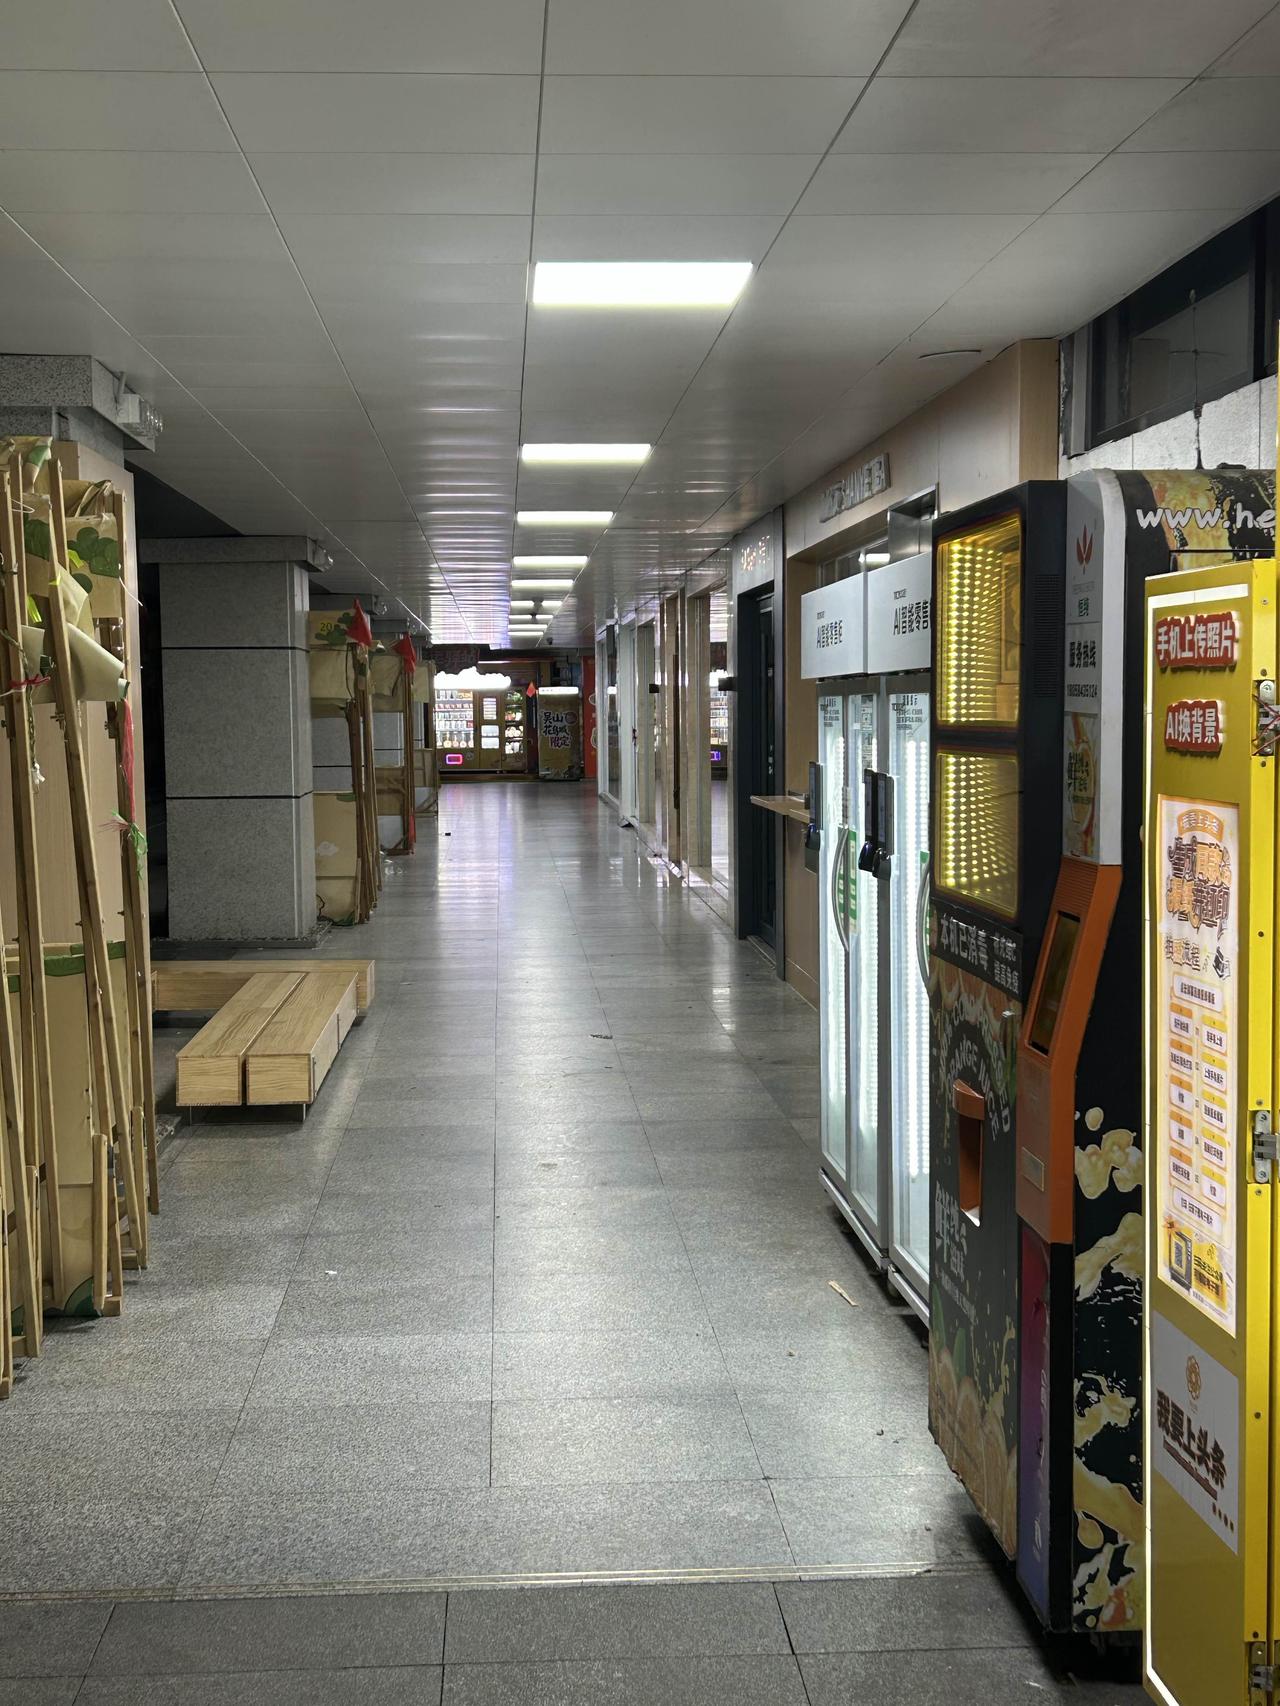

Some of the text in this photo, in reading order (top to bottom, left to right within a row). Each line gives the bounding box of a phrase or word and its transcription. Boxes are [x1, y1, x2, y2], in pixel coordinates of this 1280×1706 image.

[1157, 620, 1233, 661] 手机上传照片
[1165, 708, 1217, 744] AI换背景
[946, 1033, 1000, 1142] ORANGE JUICE
